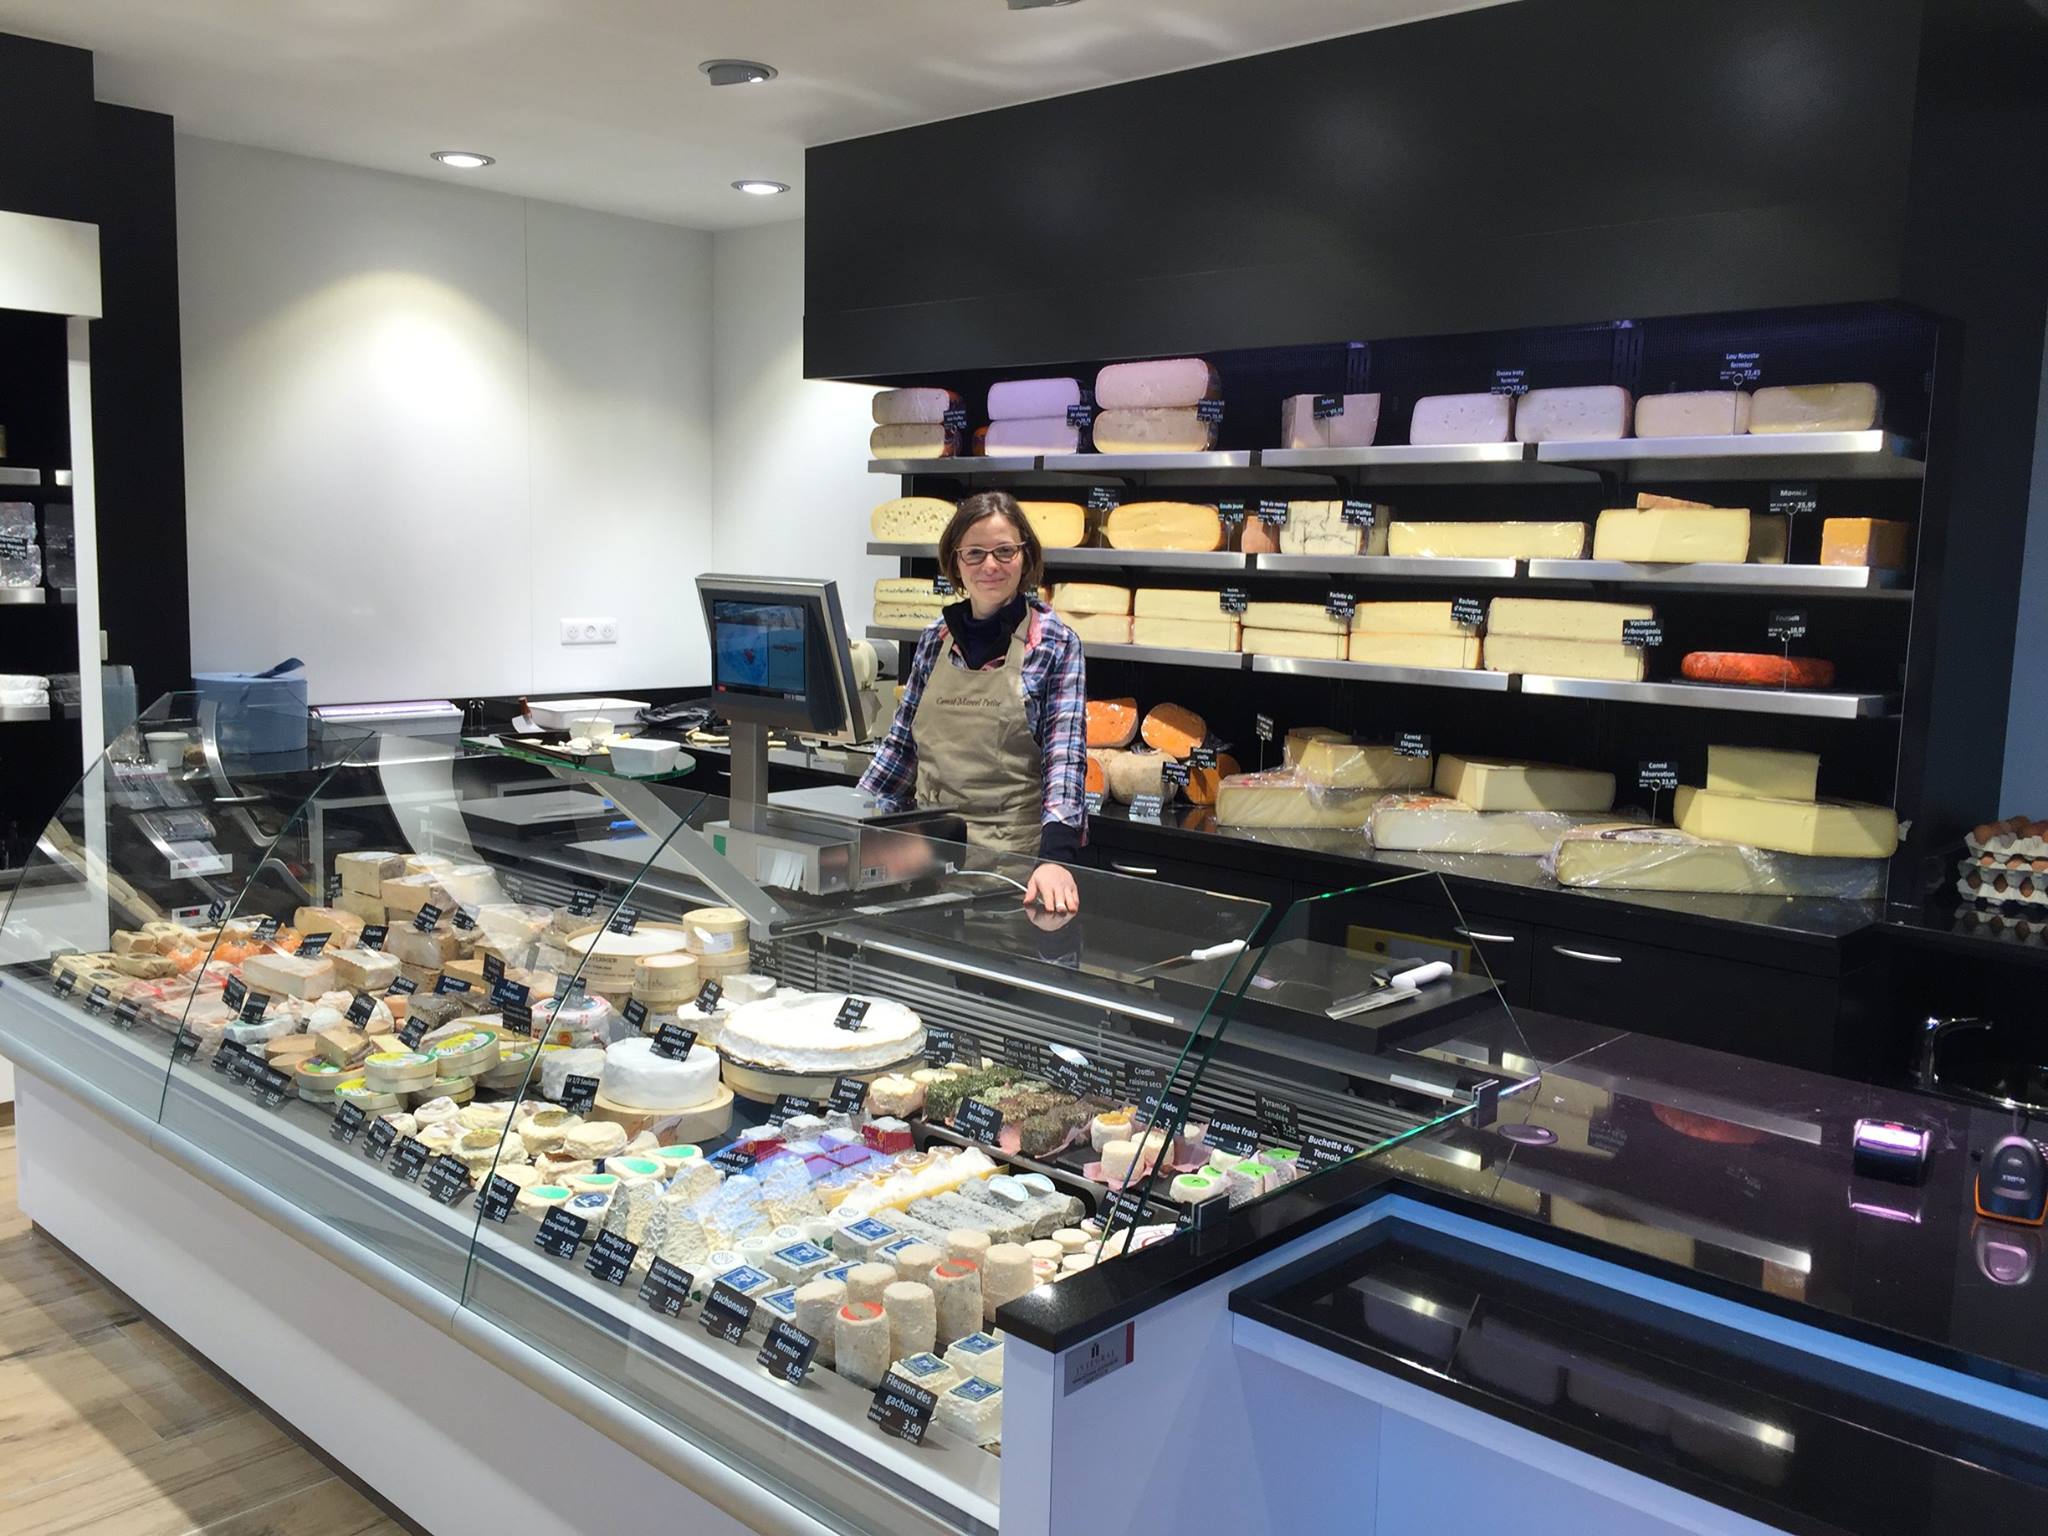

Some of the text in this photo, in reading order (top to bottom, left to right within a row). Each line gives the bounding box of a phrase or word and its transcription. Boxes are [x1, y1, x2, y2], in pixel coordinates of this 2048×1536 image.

[1641, 770, 1676, 778] Réservation
[1649, 762, 1668, 770] Comté
[1261, 1096, 1290, 1113] Pyramide
[967, 1112, 989, 1126] fermier
[1211, 1118, 1259, 1139] Le palet frais
[1308, 1135, 1354, 1154] Buchette du
[735, 1153, 749, 1164] des
[1313, 1148, 1341, 1162] Ternois
[713, 1290, 749, 1318] Gachonnais
[725, 1322, 742, 1338] 5,45
[779, 1322, 811, 1347] Clacbitou
[775, 1335, 802, 1359] fermier
[786, 1361, 803, 1378] 8,95
[886, 1373, 932, 1405] Fleuron des
[885, 1394, 919, 1418] gachons
[902, 1418, 922, 1438] 3,90
